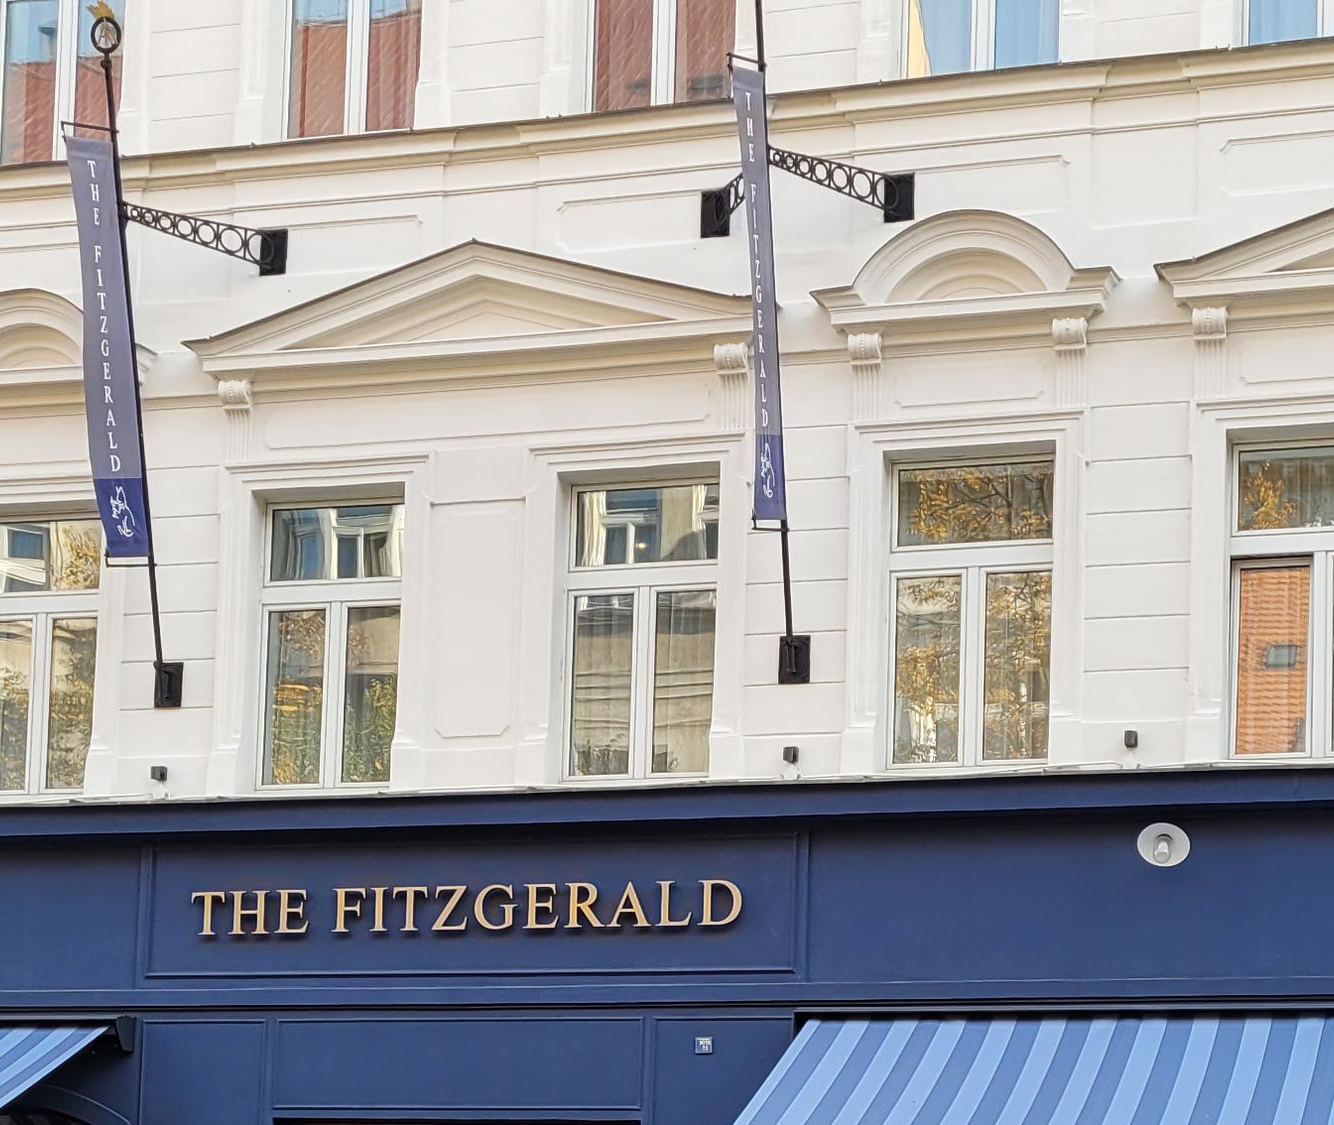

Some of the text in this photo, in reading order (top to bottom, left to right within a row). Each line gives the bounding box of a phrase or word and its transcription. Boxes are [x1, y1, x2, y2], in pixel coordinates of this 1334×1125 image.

[87, 160, 121, 473] THE FITZGERALD
[745, 92, 769, 427] THE FITZGERALD
[191, 878, 743, 936] THE FITZGERALD
